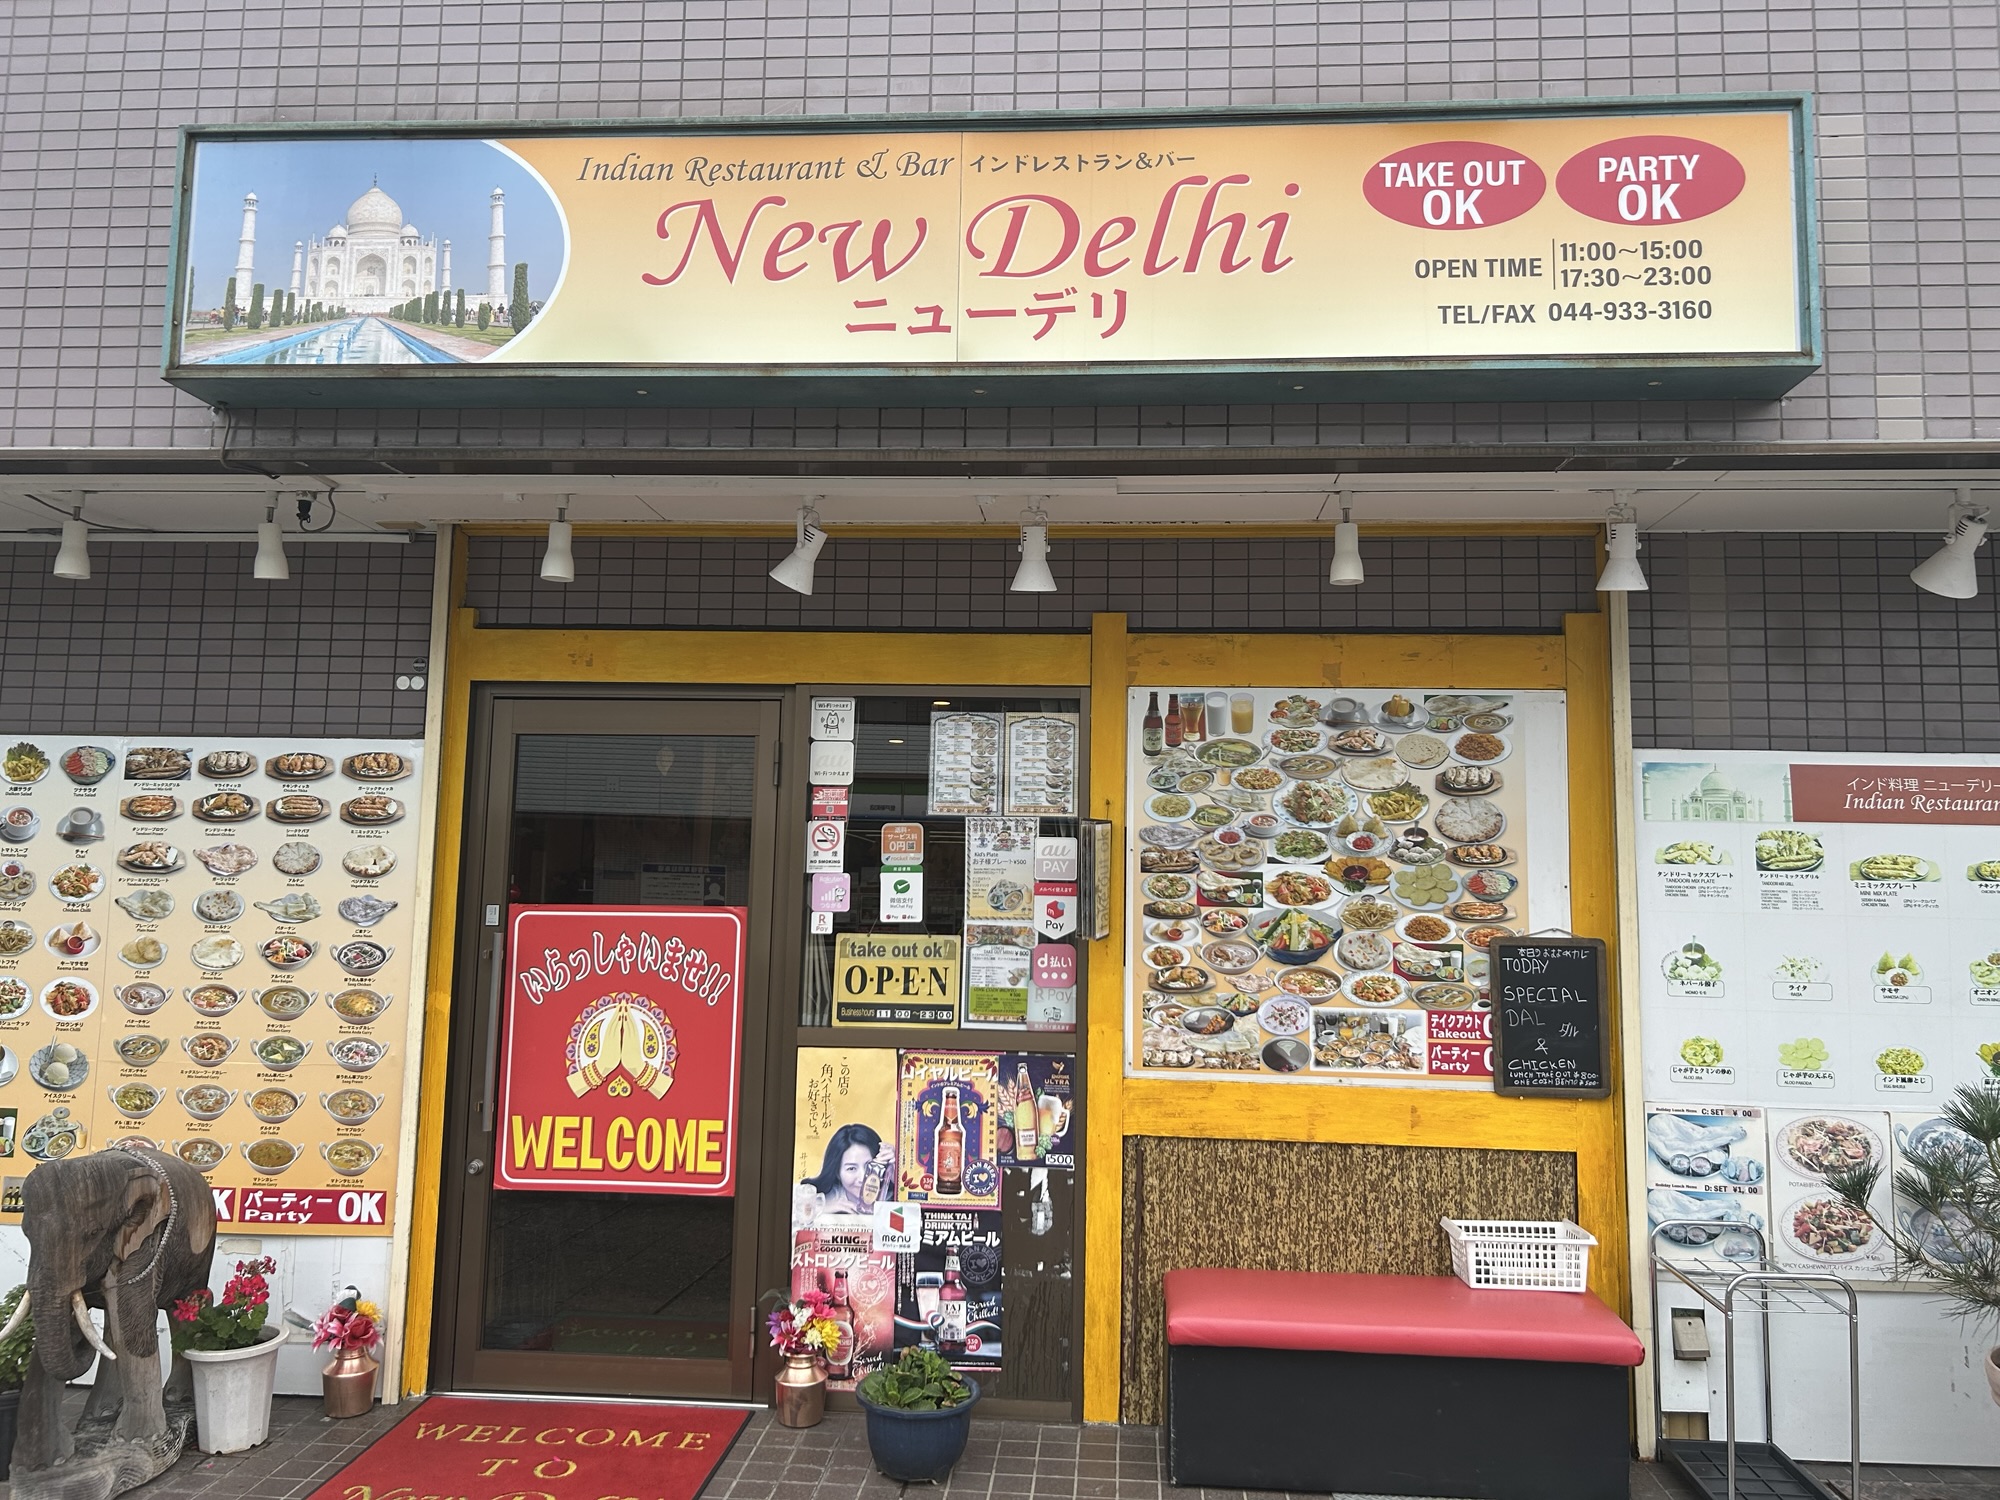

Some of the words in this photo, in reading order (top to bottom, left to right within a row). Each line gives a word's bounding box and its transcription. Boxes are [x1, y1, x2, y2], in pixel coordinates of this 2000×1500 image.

[576, 152, 674, 182] Indian
[684, 155, 846, 187] Restaurant
[856, 148, 890, 181] &
[896, 151, 955, 179] Bar
[969, 151, 1196, 174] インドレストラン&バー
[1598, 154, 1700, 183] PARTY
[1379, 161, 1454, 188] TAKE
[1463, 160, 1526, 187] OUT
[1422, 189, 1484, 226] OK
[1617, 183, 1681, 221] OK
[641, 195, 928, 286] New
[965, 173, 1300, 278] Delhi
[1415, 259, 1477, 279] OPEN
[1484, 257, 1542, 278] TIME
[845, 287, 1127, 341] ニューデリ
[1438, 304, 1536, 325] TEL/FAX
[1548, 300, 1712, 322] 044-933-3160
[1848, 778, 1919, 792] インド料理
[1843, 792, 1905, 810] Indian
[1041, 845, 1071, 856] au
[1043, 861, 1069, 873] PAY
[1046, 920, 1064, 930] Pay
[850, 941, 886, 957] take
[892, 942, 918, 958] out
[1502, 958, 1549, 974] TODAY
[1504, 986, 1587, 1003] SPECIAL
[1431, 1014, 1481, 1029] テイクアウト
[1506, 1008, 1546, 1027] DAL
[1431, 1029, 1481, 1039] Takeout
[1431, 1045, 1480, 1059] パーティー
[1432, 1061, 1470, 1072] Party
[1508, 1059, 1577, 1071] CHICKEN
[837, 1056, 850, 1095] この店の
[820, 1063, 833, 1129] 角ハイボールが
[511, 1115, 725, 1174] WELCOME
[244, 1191, 332, 1209] パーティー
[338, 1192, 384, 1223] OK
[244, 1209, 313, 1224] Party
[924, 1212, 953, 1220] THINK
[955, 1213, 972, 1221] TAJ
[924, 1222, 954, 1230] DRINK
[831, 1235, 860, 1244] KING
[791, 1253, 894, 1270] ストロングビール
[967, 1296, 996, 1313] Served
[414, 1421, 713, 1451] WELCOME
[477, 1457, 578, 1479] TO
